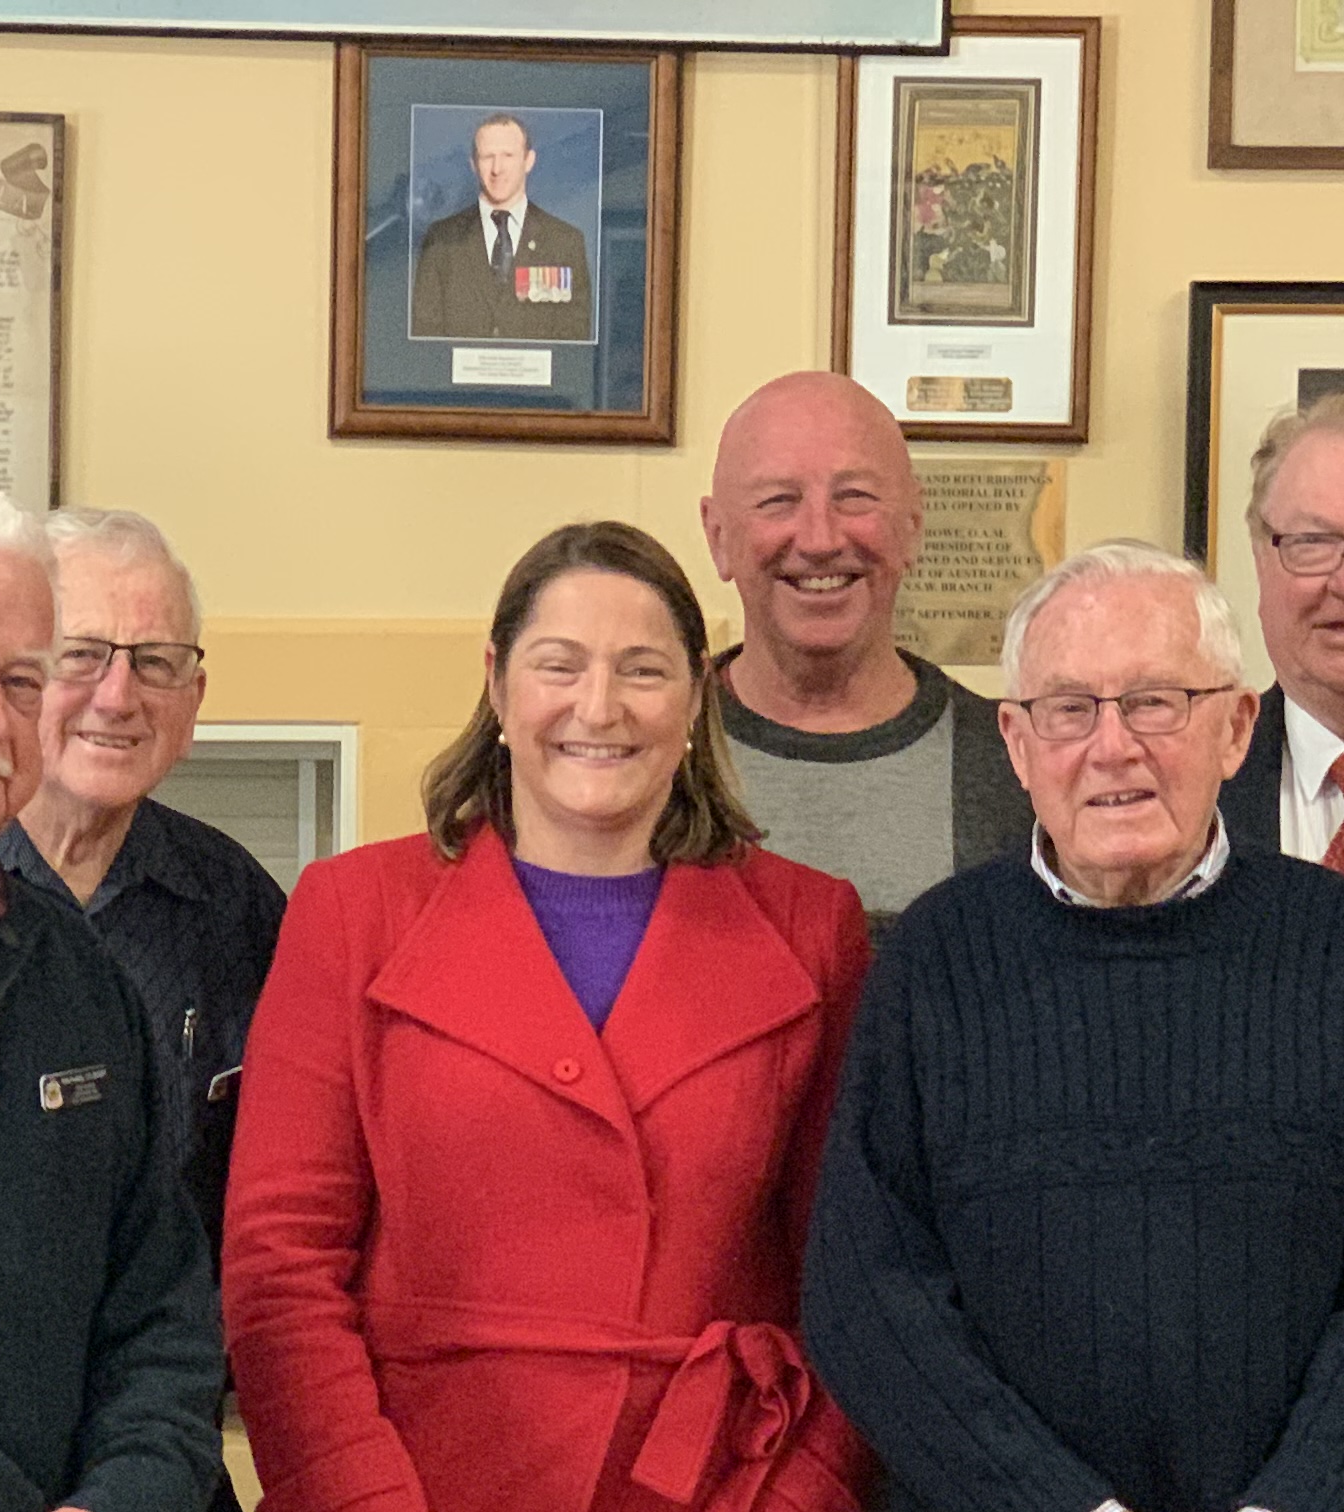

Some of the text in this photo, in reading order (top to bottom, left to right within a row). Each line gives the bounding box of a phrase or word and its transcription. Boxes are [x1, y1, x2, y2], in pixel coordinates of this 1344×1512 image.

[925, 475, 950, 485] AND
[994, 488, 1026, 498] HALL
[951, 502, 1002, 512] OPENED
[1005, 502, 1021, 512] BY
[924, 542, 1012, 552] PRESIDENT OF
[954, 555, 979, 565] AND
[981, 555, 1043, 565] SERVICES
[927, 569, 943, 579] OF
[940, 582, 993, 592] BRANCH
